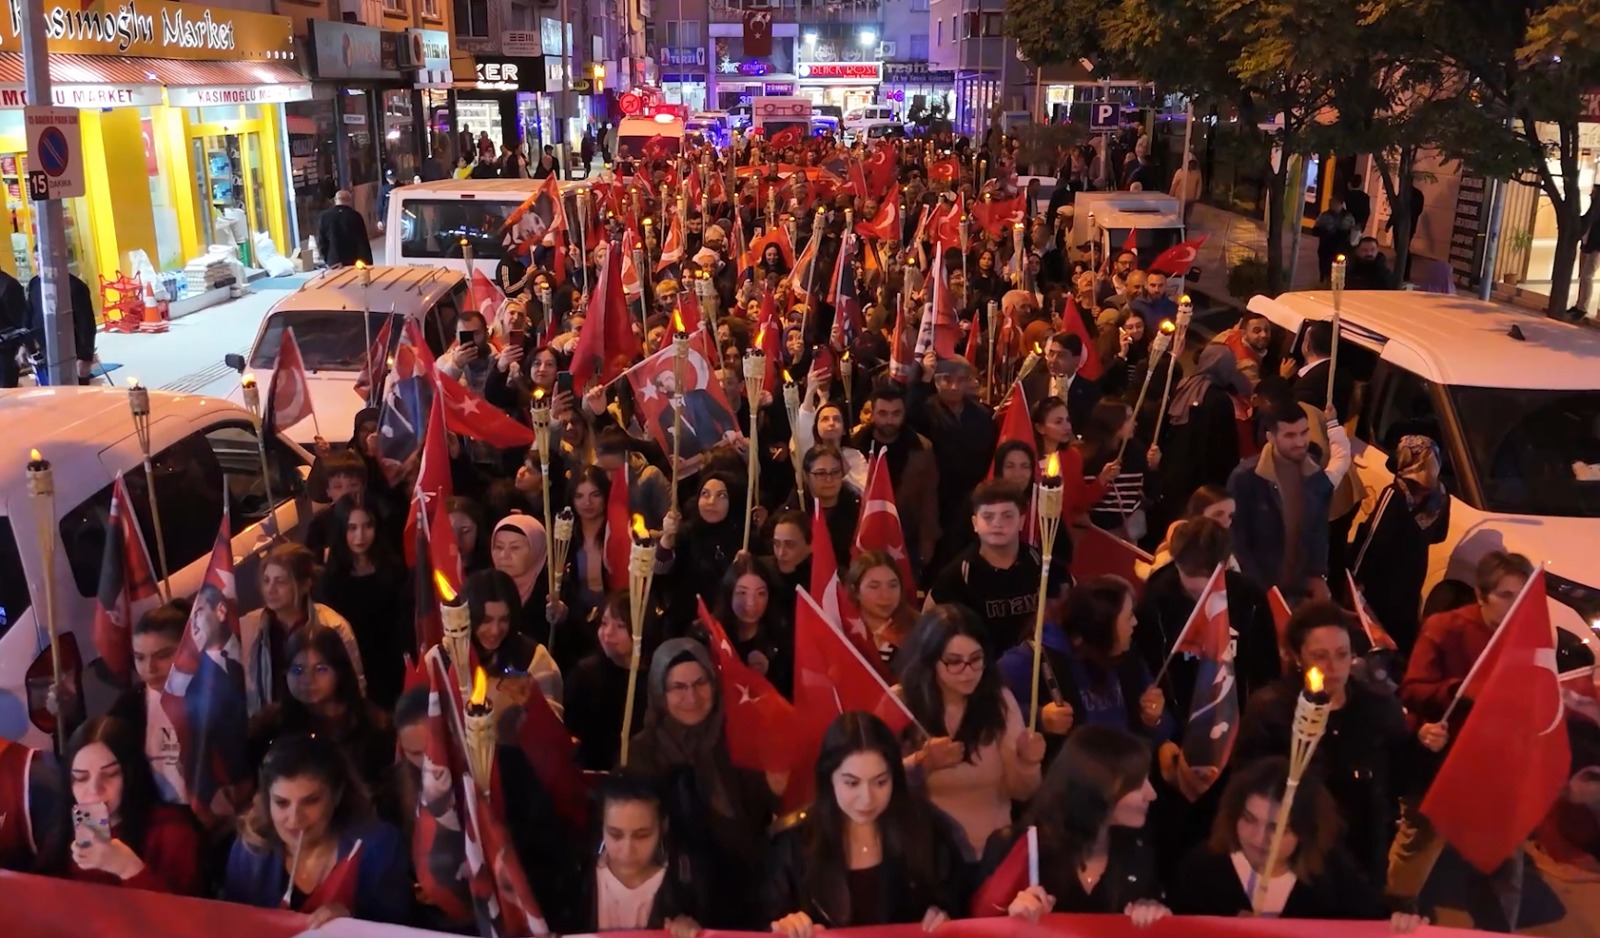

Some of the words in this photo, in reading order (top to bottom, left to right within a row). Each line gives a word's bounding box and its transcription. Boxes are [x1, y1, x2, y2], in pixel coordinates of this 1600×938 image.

[161, 7, 235, 50] Market
[1098, 105, 1113, 125] P
[32, 174, 47, 194] 15
